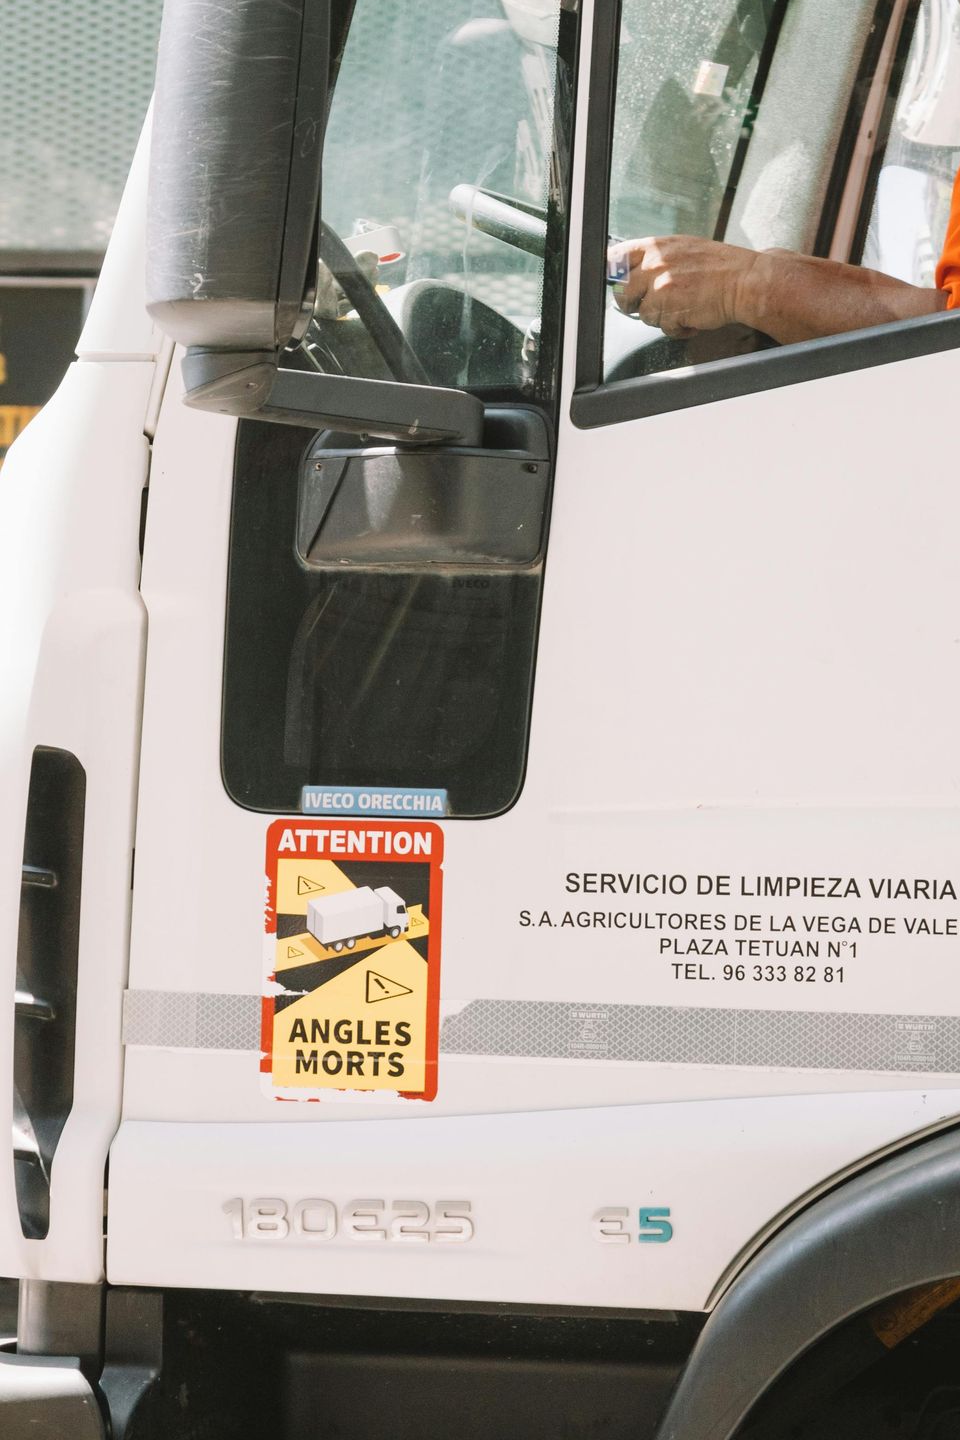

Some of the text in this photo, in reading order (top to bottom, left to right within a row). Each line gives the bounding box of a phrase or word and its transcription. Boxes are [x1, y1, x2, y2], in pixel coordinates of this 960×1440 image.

[305, 793, 443, 810] IVECO ORECCHIA
[278, 829, 432, 854] ATTENTION
[566, 873, 957, 900] SERVICIO DE LIMPIEZA VIARIA
[735, 914, 761, 931] DE
[770, 915, 796, 932] LA
[803, 916, 861, 933] VEGA
[869, 917, 896, 934] DE
[660, 938, 728, 956] PLAZA
[735, 939, 818, 957] TETUAN
[672, 963, 844, 983] TEL. 96 333 82 81
[289, 1018, 412, 1047] ANGLES
[295, 1049, 405, 1078] MORTS
[221, 1197, 476, 1244] 180E25
